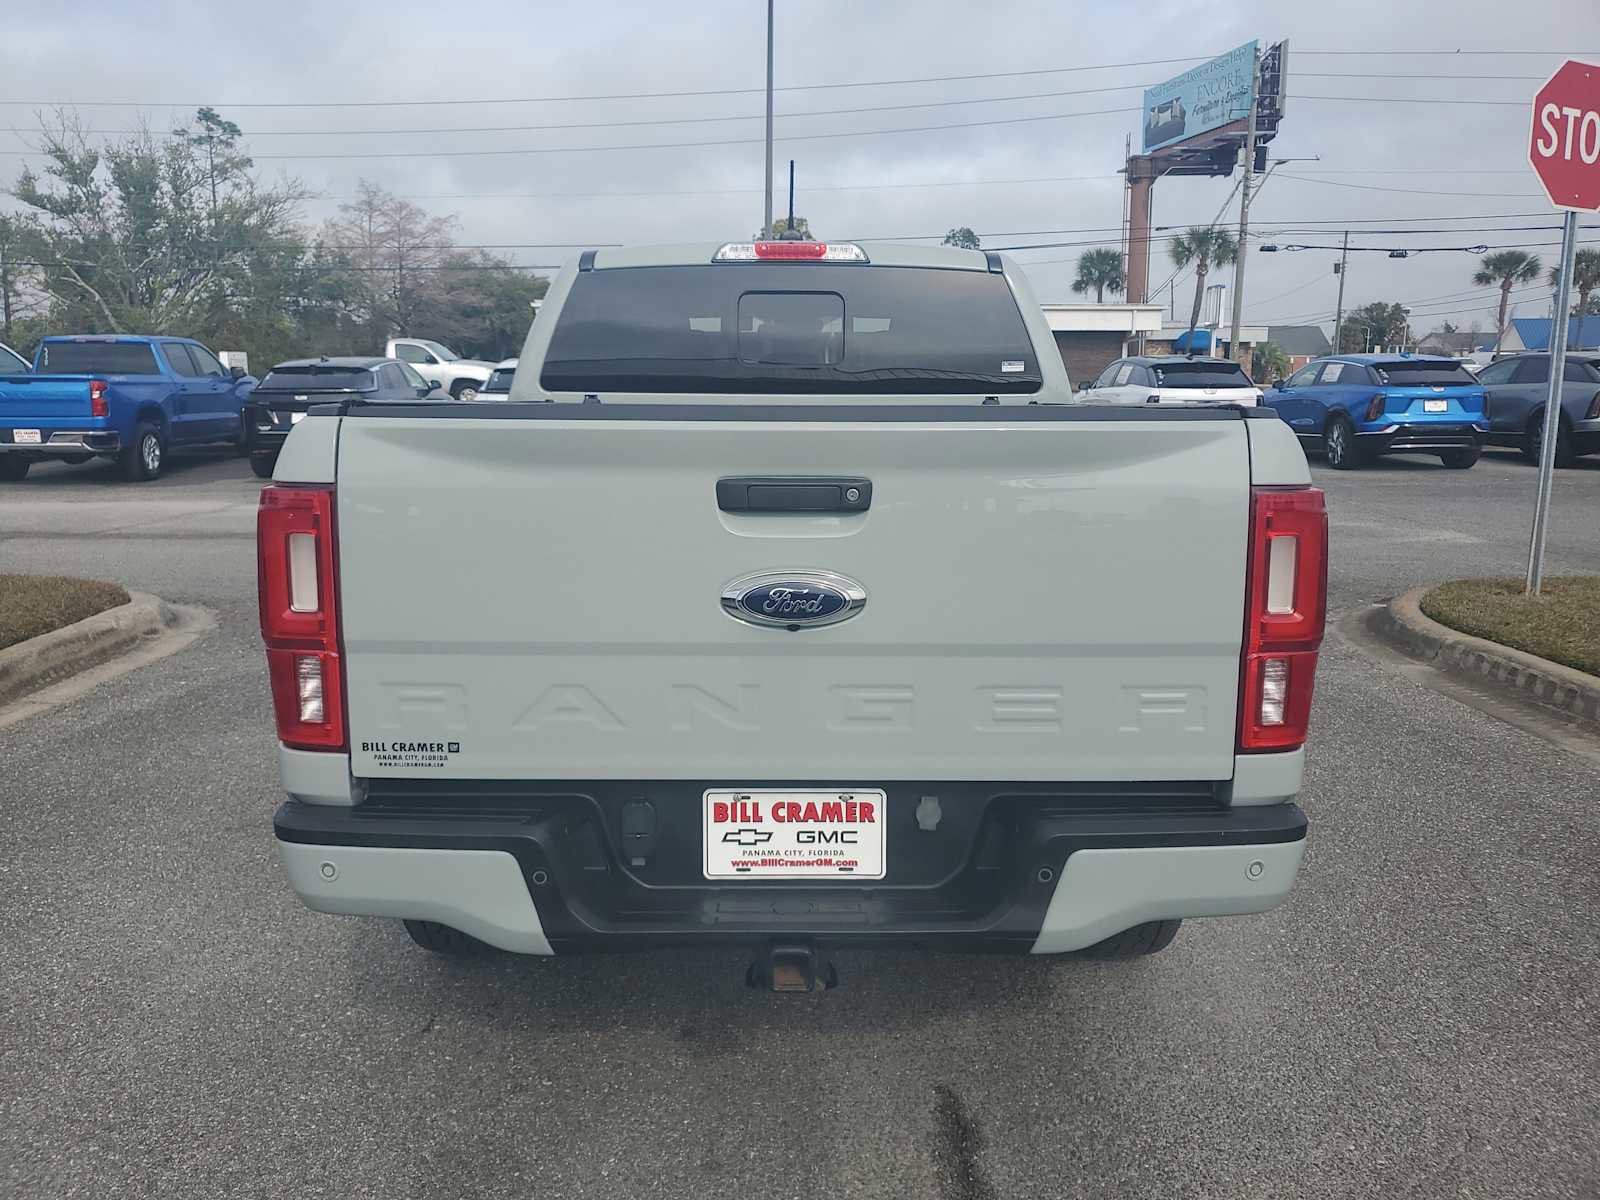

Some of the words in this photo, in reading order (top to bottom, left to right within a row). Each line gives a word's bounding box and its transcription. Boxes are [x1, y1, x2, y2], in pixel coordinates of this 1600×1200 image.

[1537, 103, 1600, 164] STO
[763, 588, 825, 613] Ford
[379, 681, 1208, 733] RANGER
[362, 742, 387, 752] BILL
[391, 742, 444, 752] CRAMER
[713, 802, 763, 823] BILL
[771, 802, 876, 823] CRAMER
[796, 831, 858, 844] GMC
[784, 850, 805, 858] CITY,
[731, 858, 858, 868] www.BillCramerGM.com
